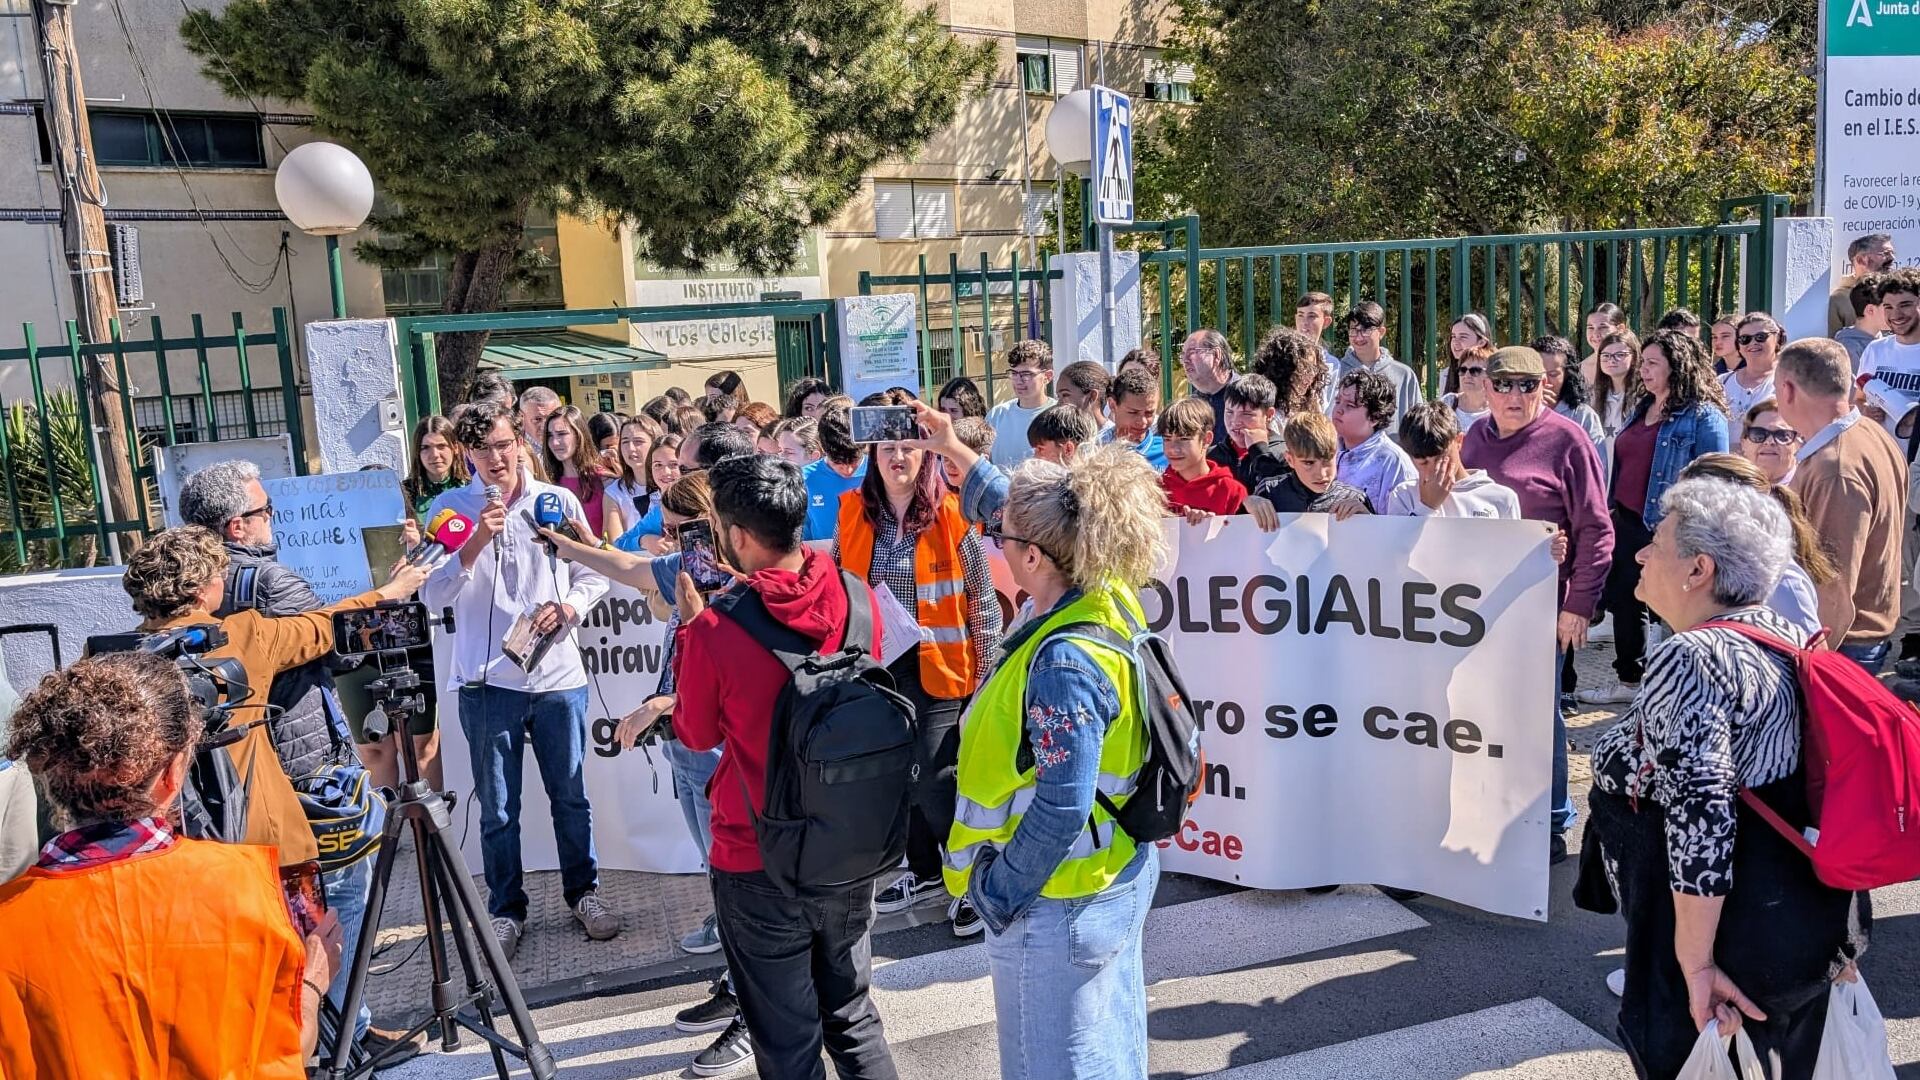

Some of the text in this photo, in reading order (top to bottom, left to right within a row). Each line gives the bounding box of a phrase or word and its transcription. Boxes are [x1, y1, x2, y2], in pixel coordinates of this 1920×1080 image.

[1876, 0, 1920, 15] Junta d
[1845, 88, 1903, 107] Cambio
[1844, 118, 1920, 136] en el I.E.S.
[1843, 173, 1898, 188] Favorecer
[1900, 172, 1910, 187] la
[1844, 196, 1858, 210] de
[1861, 194, 1914, 209] COVID-19
[1843, 216, 1915, 233] recuperación
[683, 281, 755, 299] INSTITUTO
[581, 597, 653, 635] mpa
[1140, 574, 1486, 648] OLEGIALES
[1194, 699, 1504, 759] ro se cae.
[1204, 760, 1246, 800] n.
